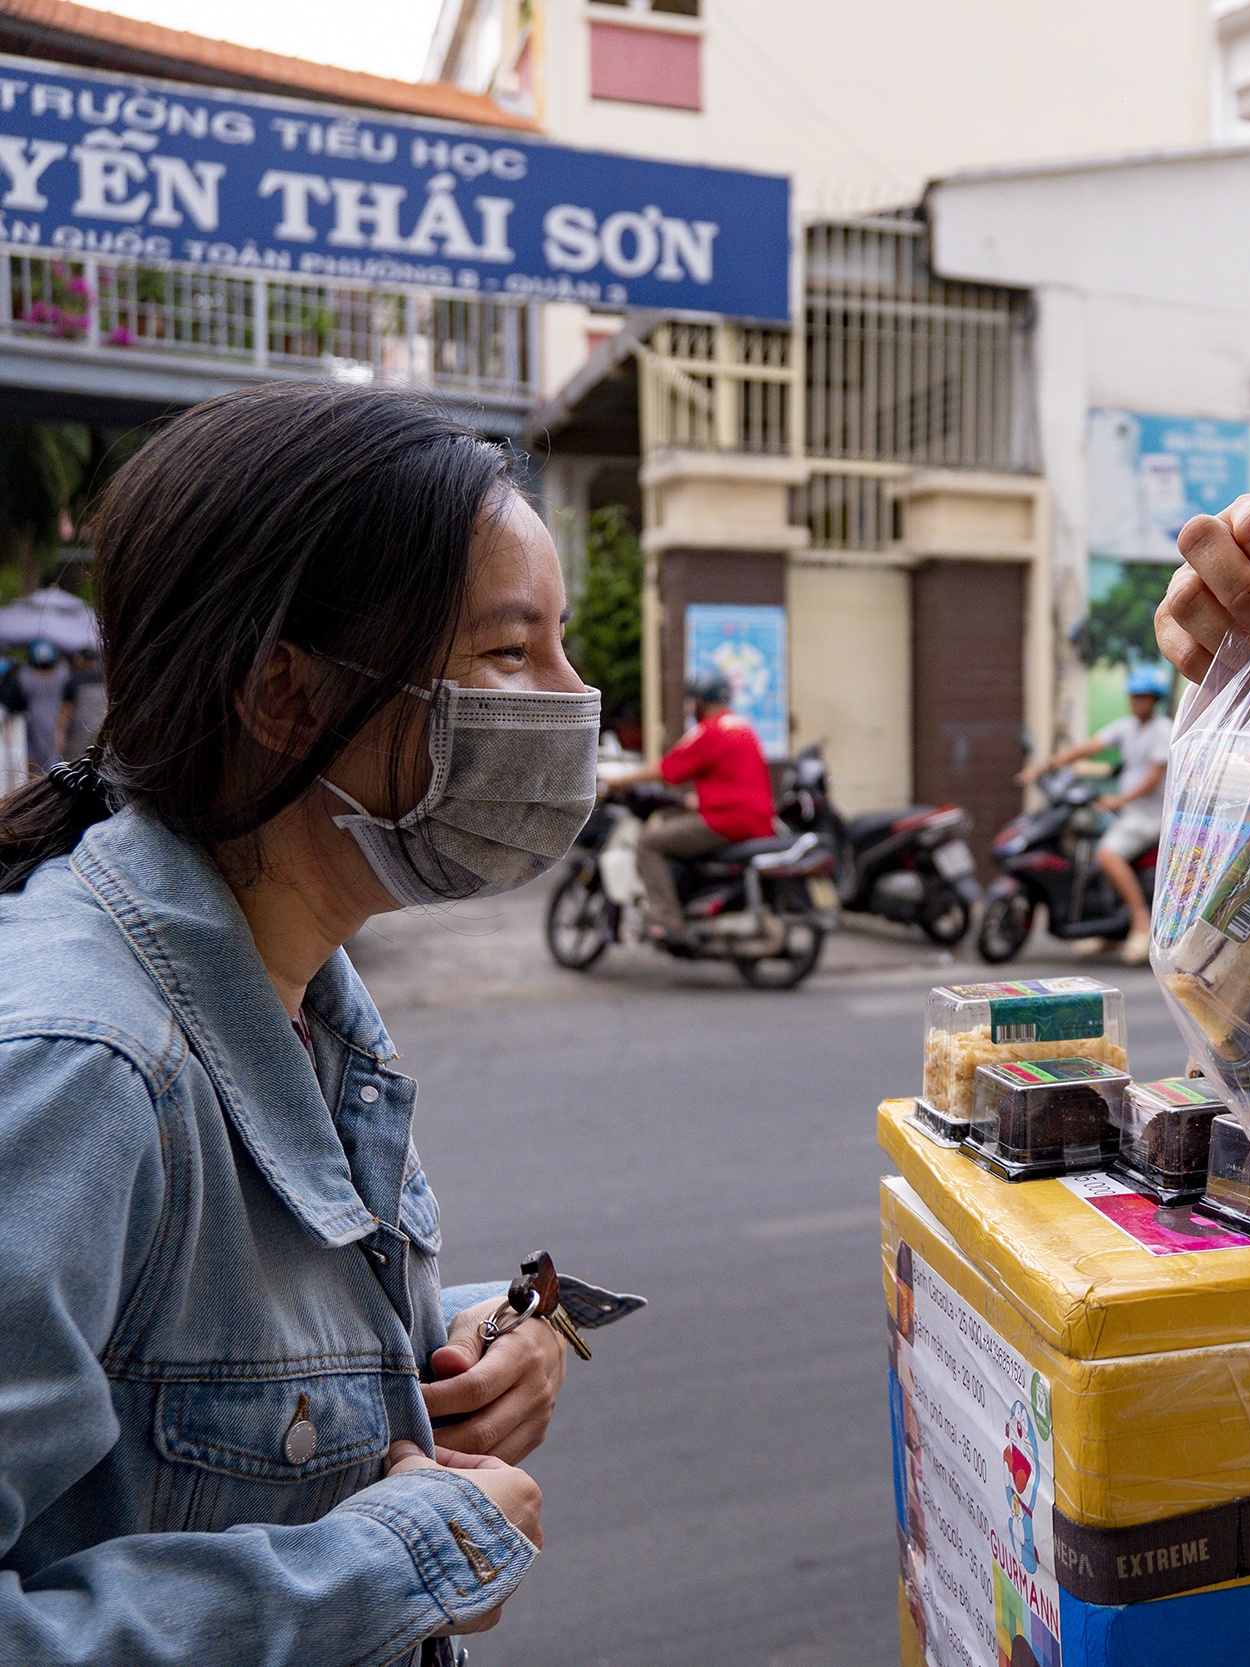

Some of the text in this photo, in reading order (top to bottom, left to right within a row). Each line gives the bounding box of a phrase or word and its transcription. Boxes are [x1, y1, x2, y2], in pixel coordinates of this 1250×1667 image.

[411, 139, 529, 181] HỌC
[258, 171, 515, 264] THÁI
[543, 204, 720, 285] SƠN
[958, 1307, 968, 1336] 25
[961, 1365, 970, 1391] 29
[971, 1374, 985, 1409] 000
[962, 1433, 971, 1463] 35
[973, 1447, 987, 1484] 000
[968, 1547, 978, 1580] 35
[1116, 1538, 1211, 1579] EXTREME
[990, 1529, 1060, 1640] GUURMANN
